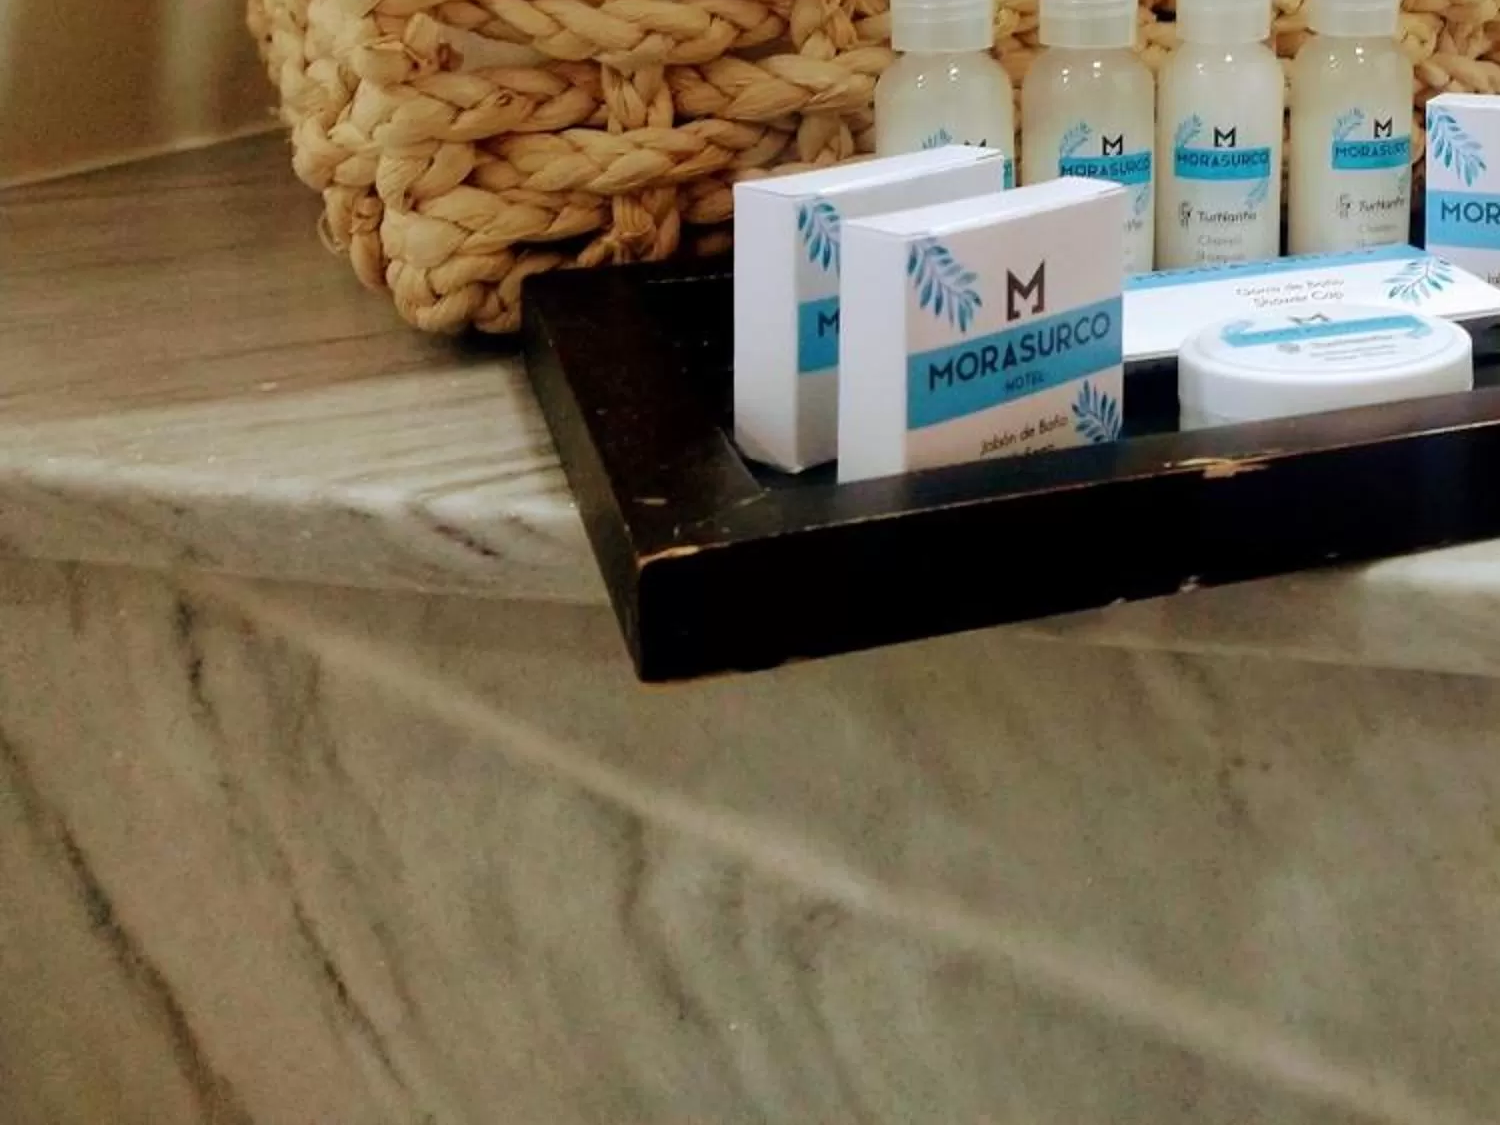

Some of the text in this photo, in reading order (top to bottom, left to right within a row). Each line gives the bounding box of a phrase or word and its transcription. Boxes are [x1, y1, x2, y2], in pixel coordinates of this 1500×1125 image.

[1102, 134, 1123, 156] M
[1213, 126, 1236, 148] M
[1177, 152, 1269, 168] MORASURCO
[1007, 259, 1045, 321] M
[928, 311, 1111, 392] MORASURCO
[1005, 371, 1045, 392] HOTEL
[1020, 423, 1036, 441] de
